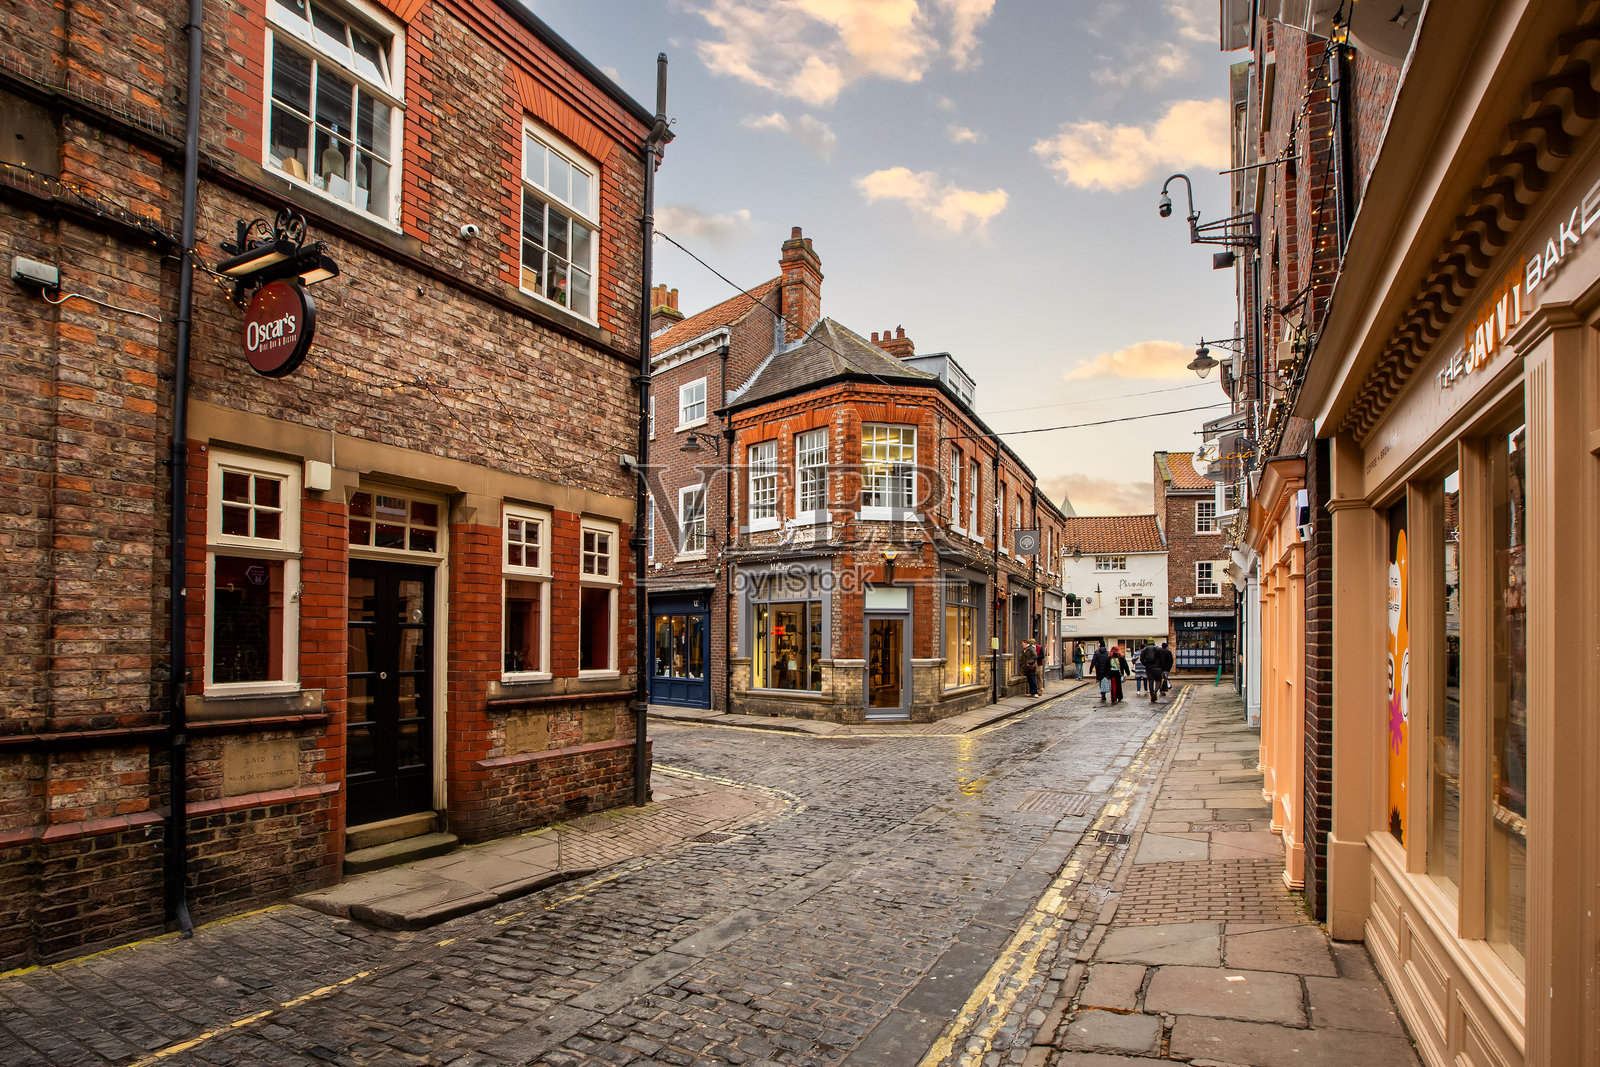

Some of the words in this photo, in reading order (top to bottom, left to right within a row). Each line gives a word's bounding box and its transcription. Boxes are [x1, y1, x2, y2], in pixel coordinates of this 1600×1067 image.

[247, 312, 297, 351] Oscar's
[1436, 346, 1463, 391] THE
[1464, 253, 1526, 375] SAVVY
[1195, 446, 1257, 463] Lucia
